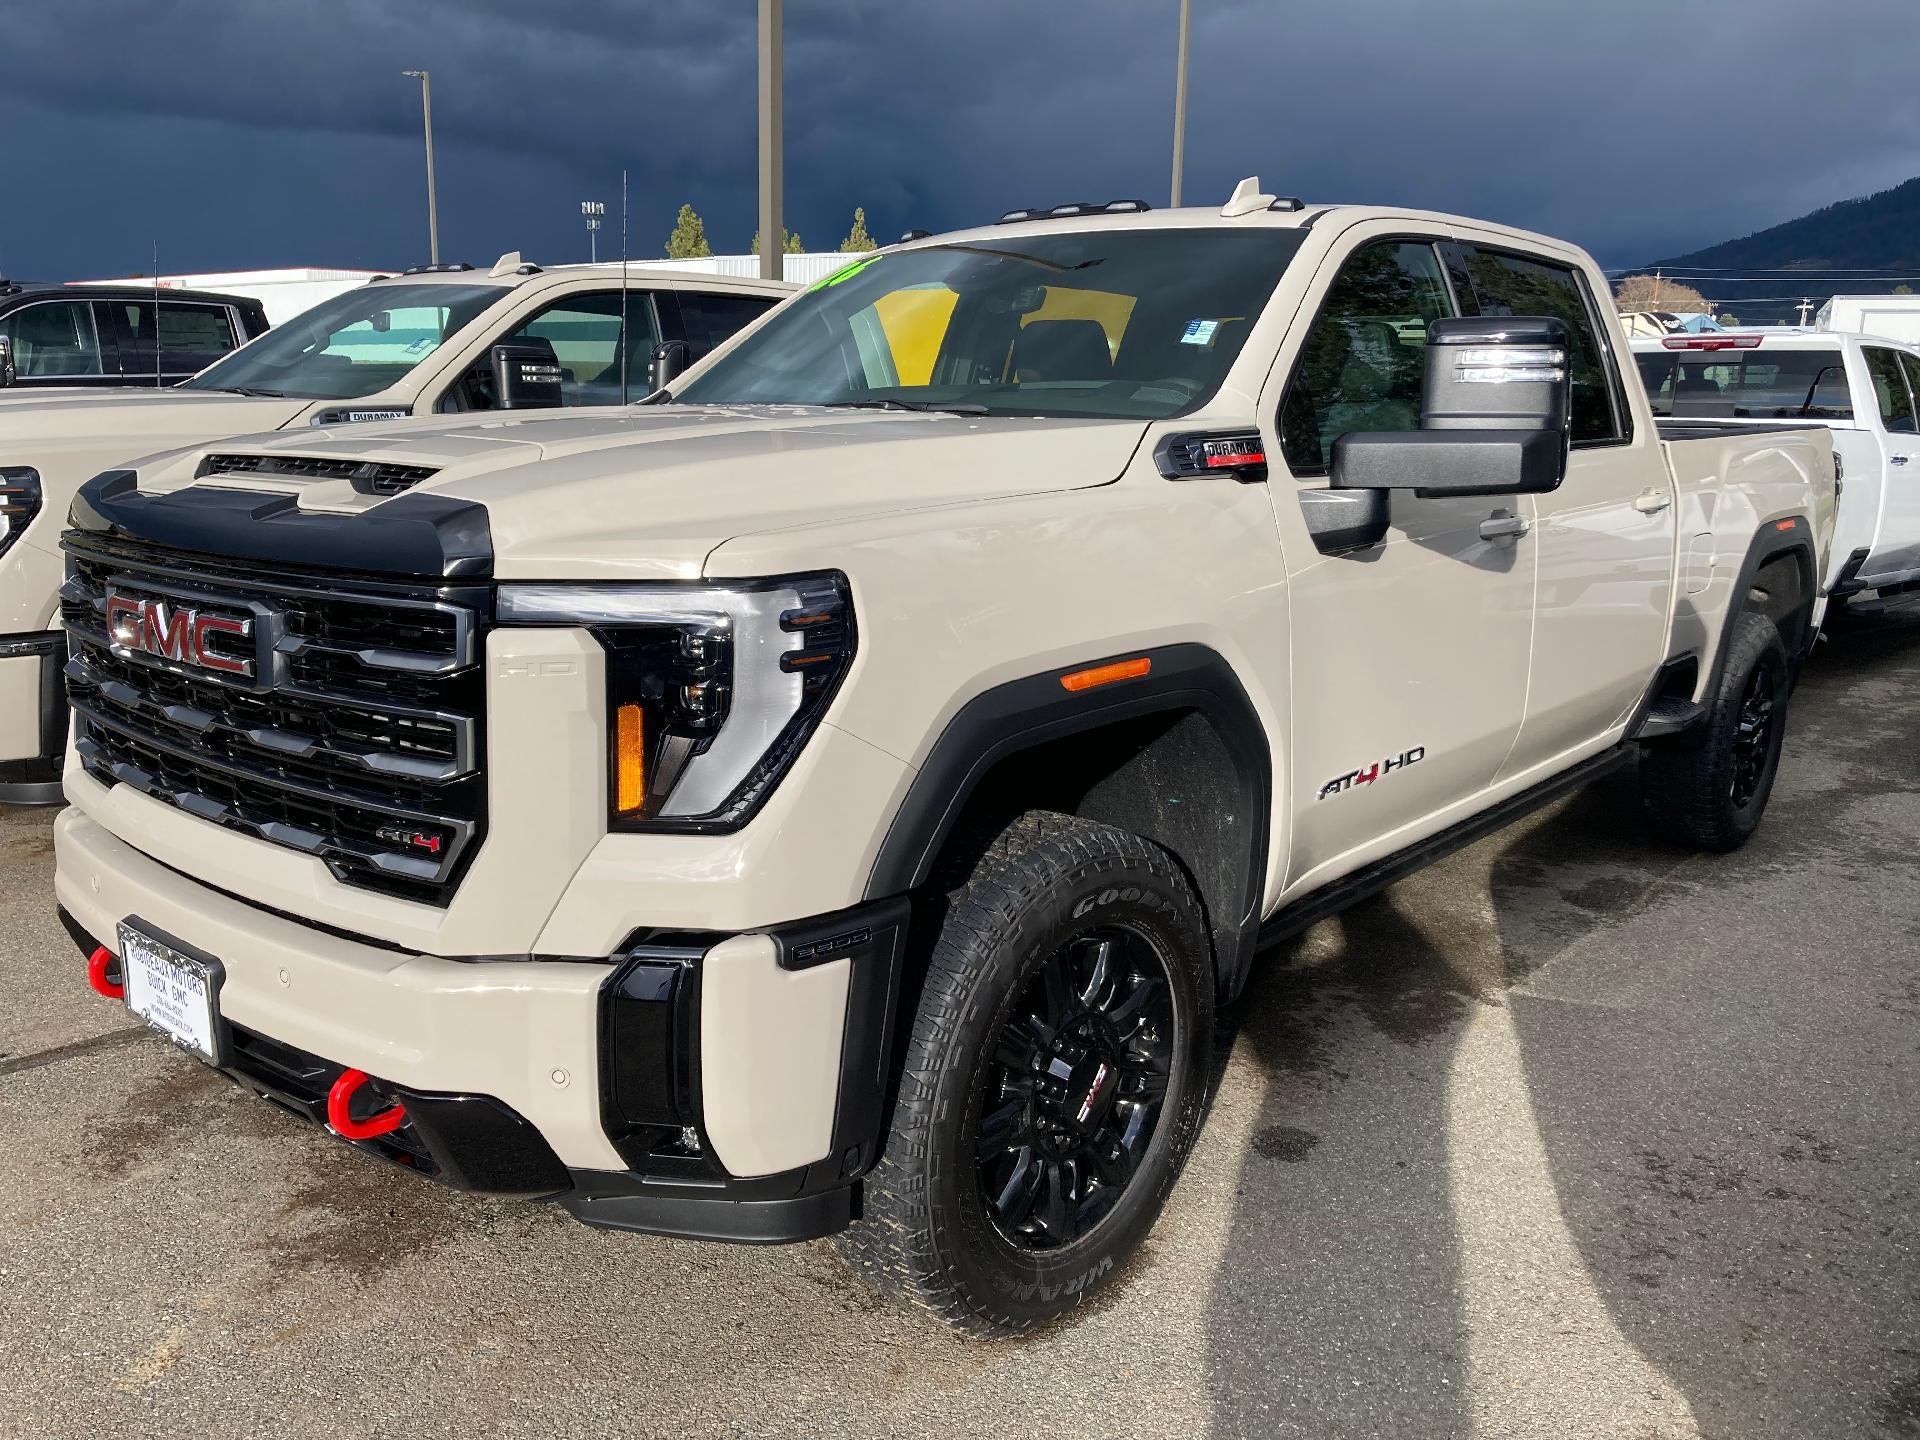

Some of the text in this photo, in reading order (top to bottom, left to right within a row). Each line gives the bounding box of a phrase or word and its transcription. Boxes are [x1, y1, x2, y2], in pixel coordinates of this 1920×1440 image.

[106, 594, 256, 677] GMC
[1316, 745, 1425, 800] AT4 HD
[171, 985, 189, 1008] GMC
